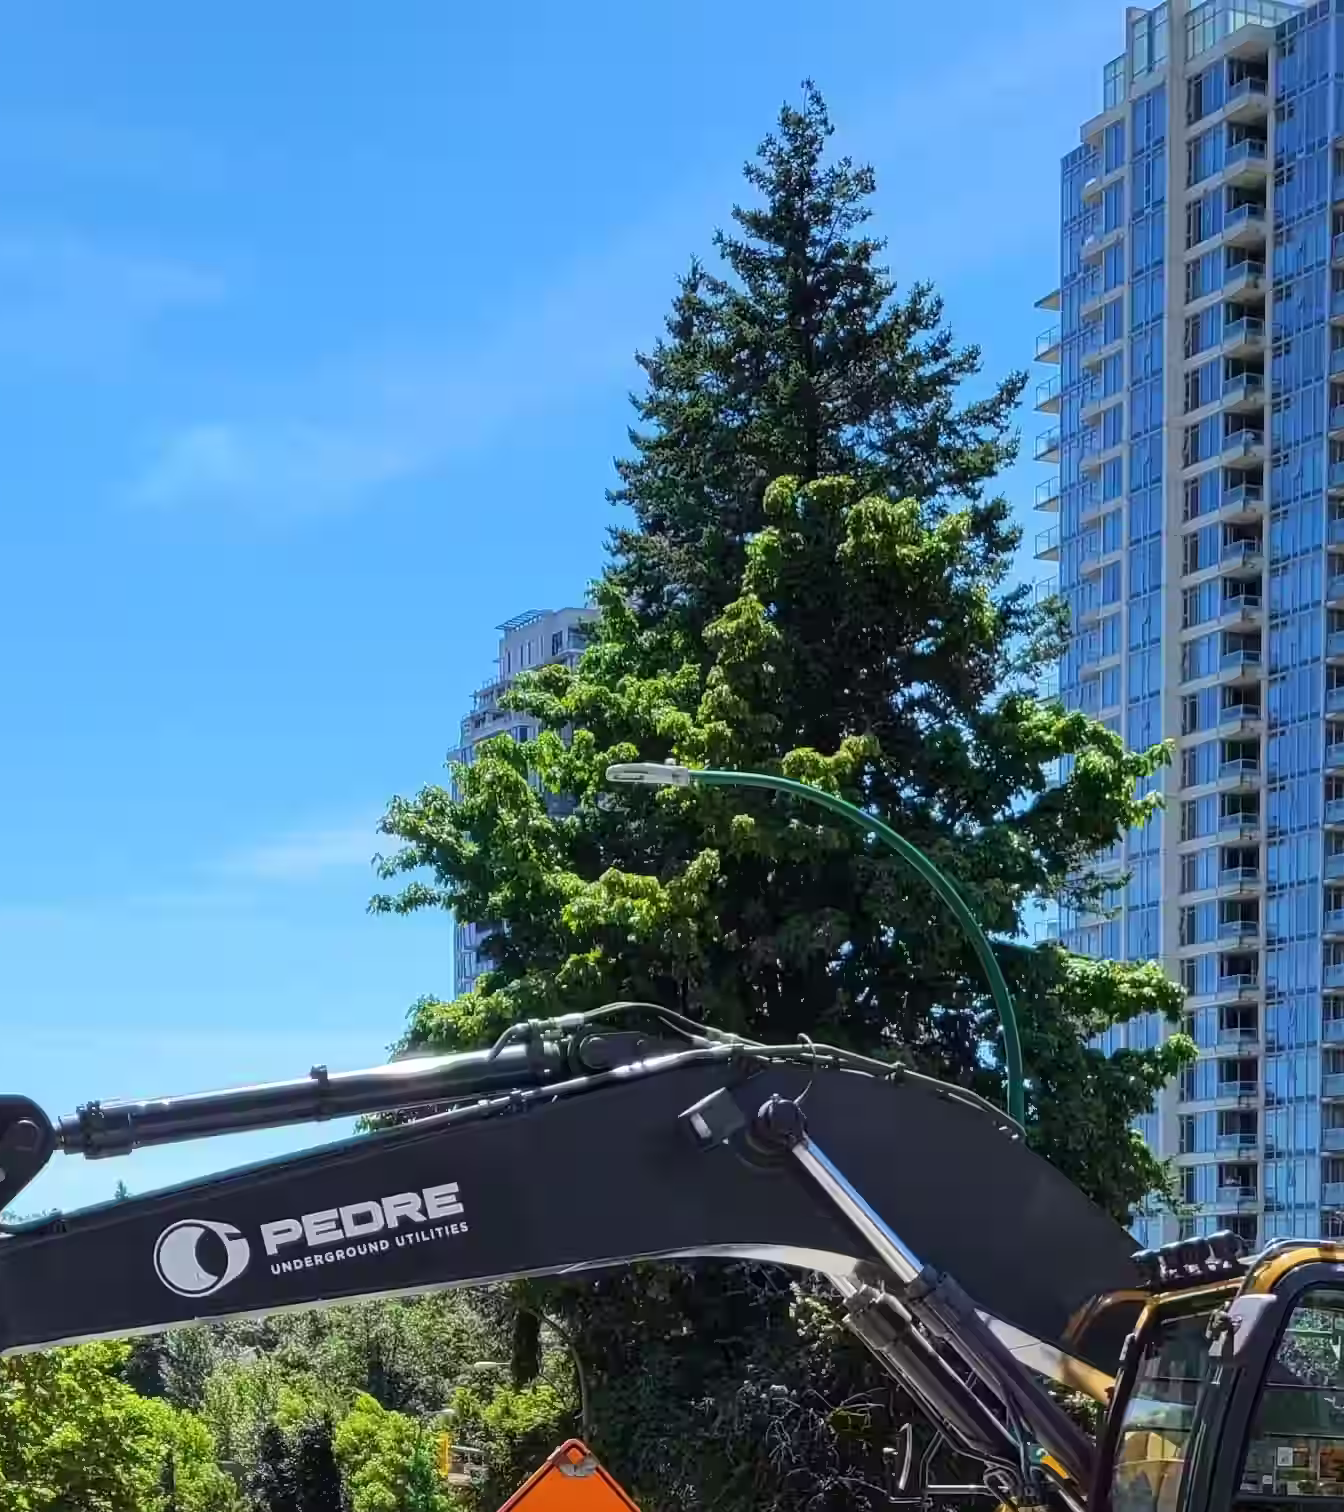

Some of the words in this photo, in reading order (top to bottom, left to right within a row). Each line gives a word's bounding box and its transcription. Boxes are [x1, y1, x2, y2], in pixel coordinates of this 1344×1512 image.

[260, 1182, 464, 1256] PEDRE
[270, 1239, 390, 1275] UNDERGROUND
[395, 1222, 469, 1247] UTILITIES
